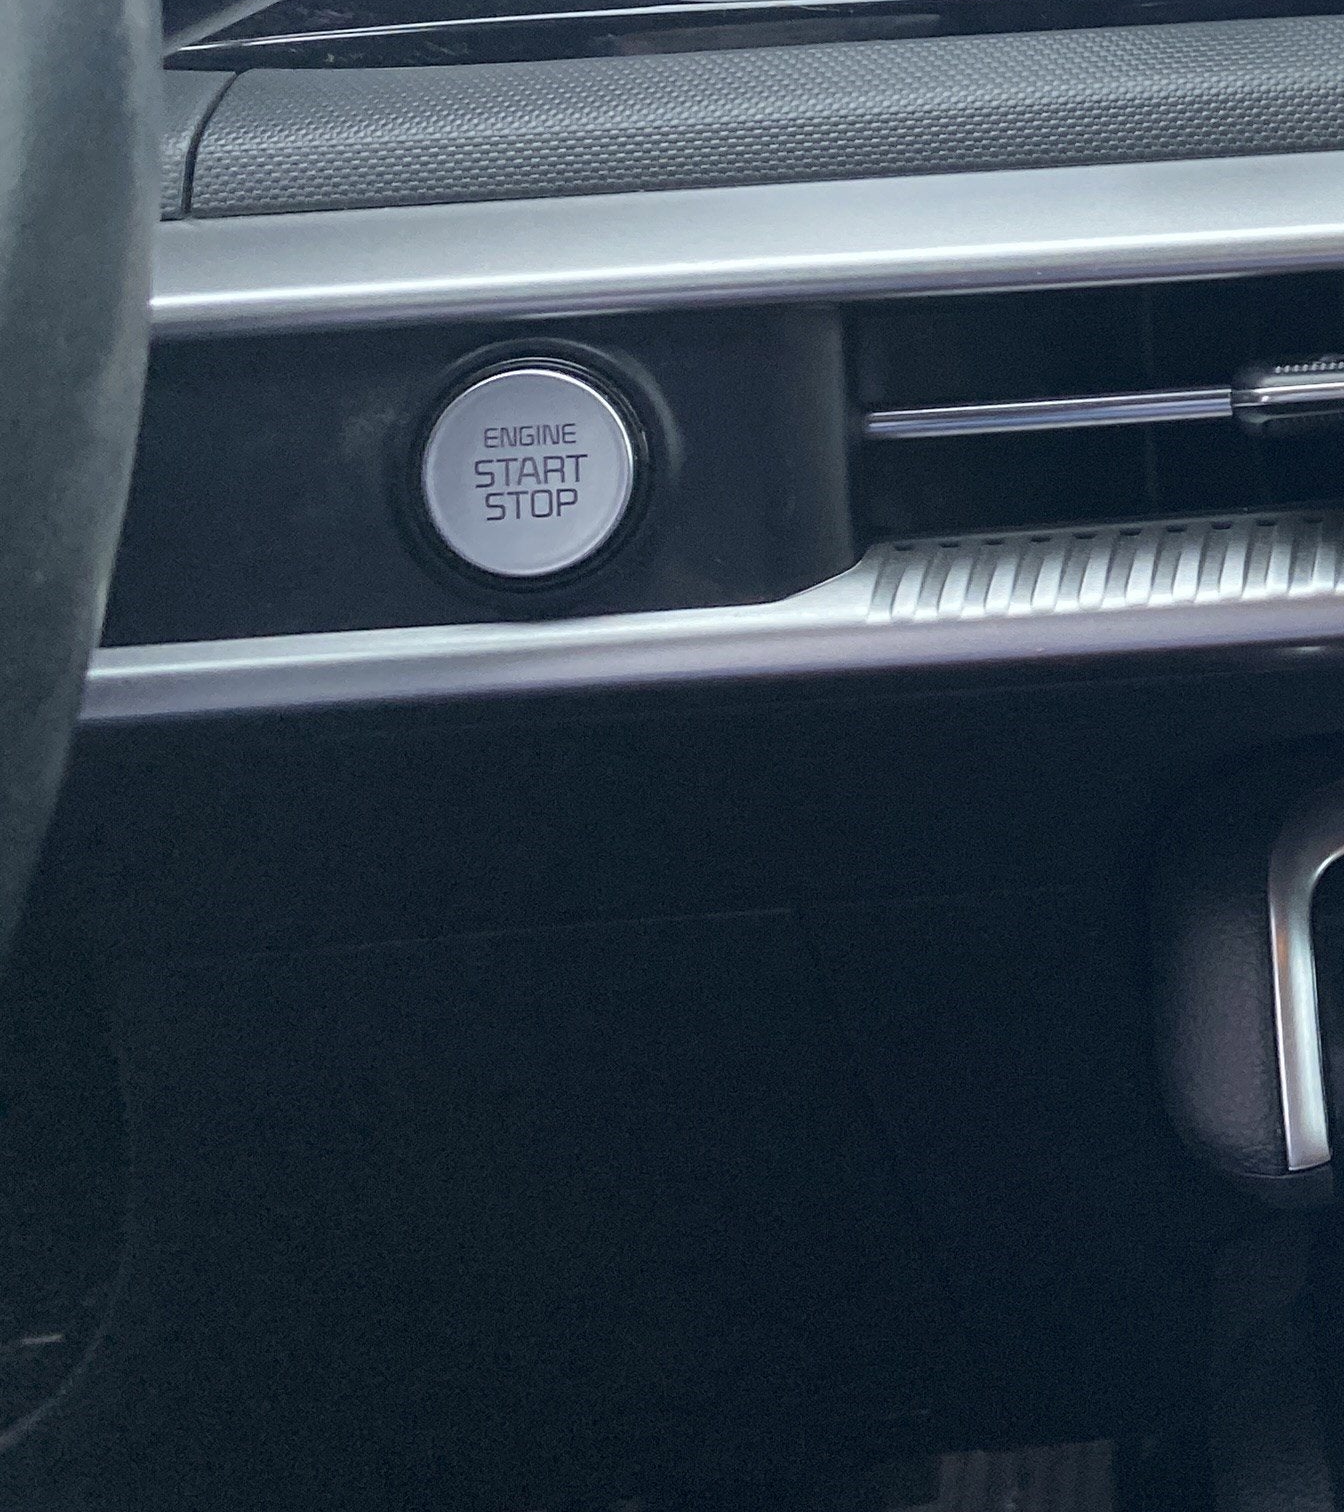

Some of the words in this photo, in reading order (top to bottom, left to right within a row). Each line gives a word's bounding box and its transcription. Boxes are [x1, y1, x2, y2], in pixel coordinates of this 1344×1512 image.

[484, 423, 577, 448] ENGINE
[474, 454, 588, 489] START
[485, 488, 578, 521] STOP
